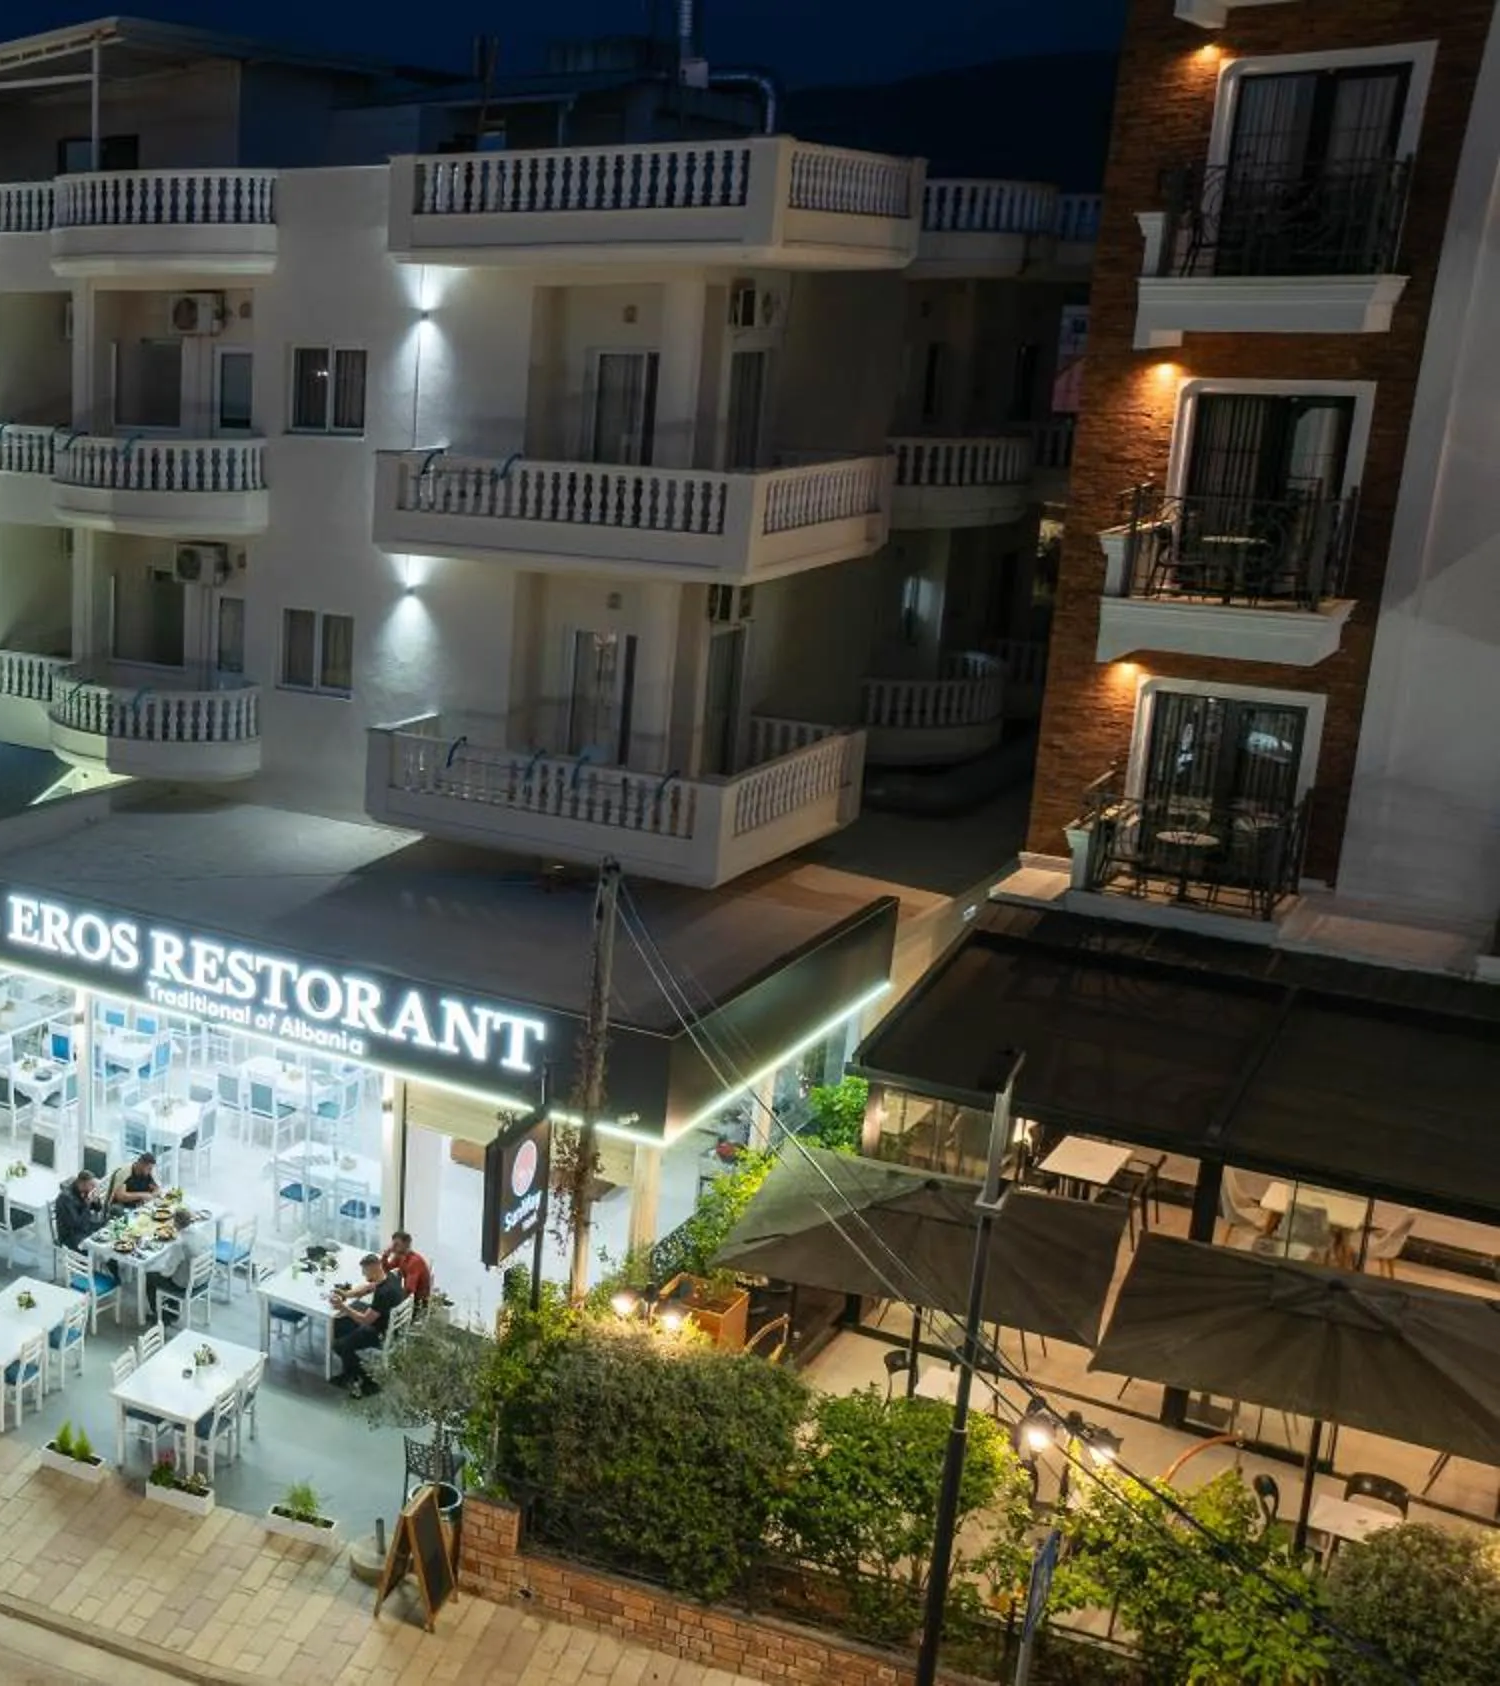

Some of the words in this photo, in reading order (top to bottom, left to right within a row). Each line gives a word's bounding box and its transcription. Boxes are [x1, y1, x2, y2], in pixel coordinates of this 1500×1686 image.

[6, 894, 141, 970] EROS
[149, 930, 546, 1073] RESTORANT
[147, 981, 250, 1025] Traditional
[254, 1011, 277, 1032] of
[279, 1016, 365, 1056] Albania
